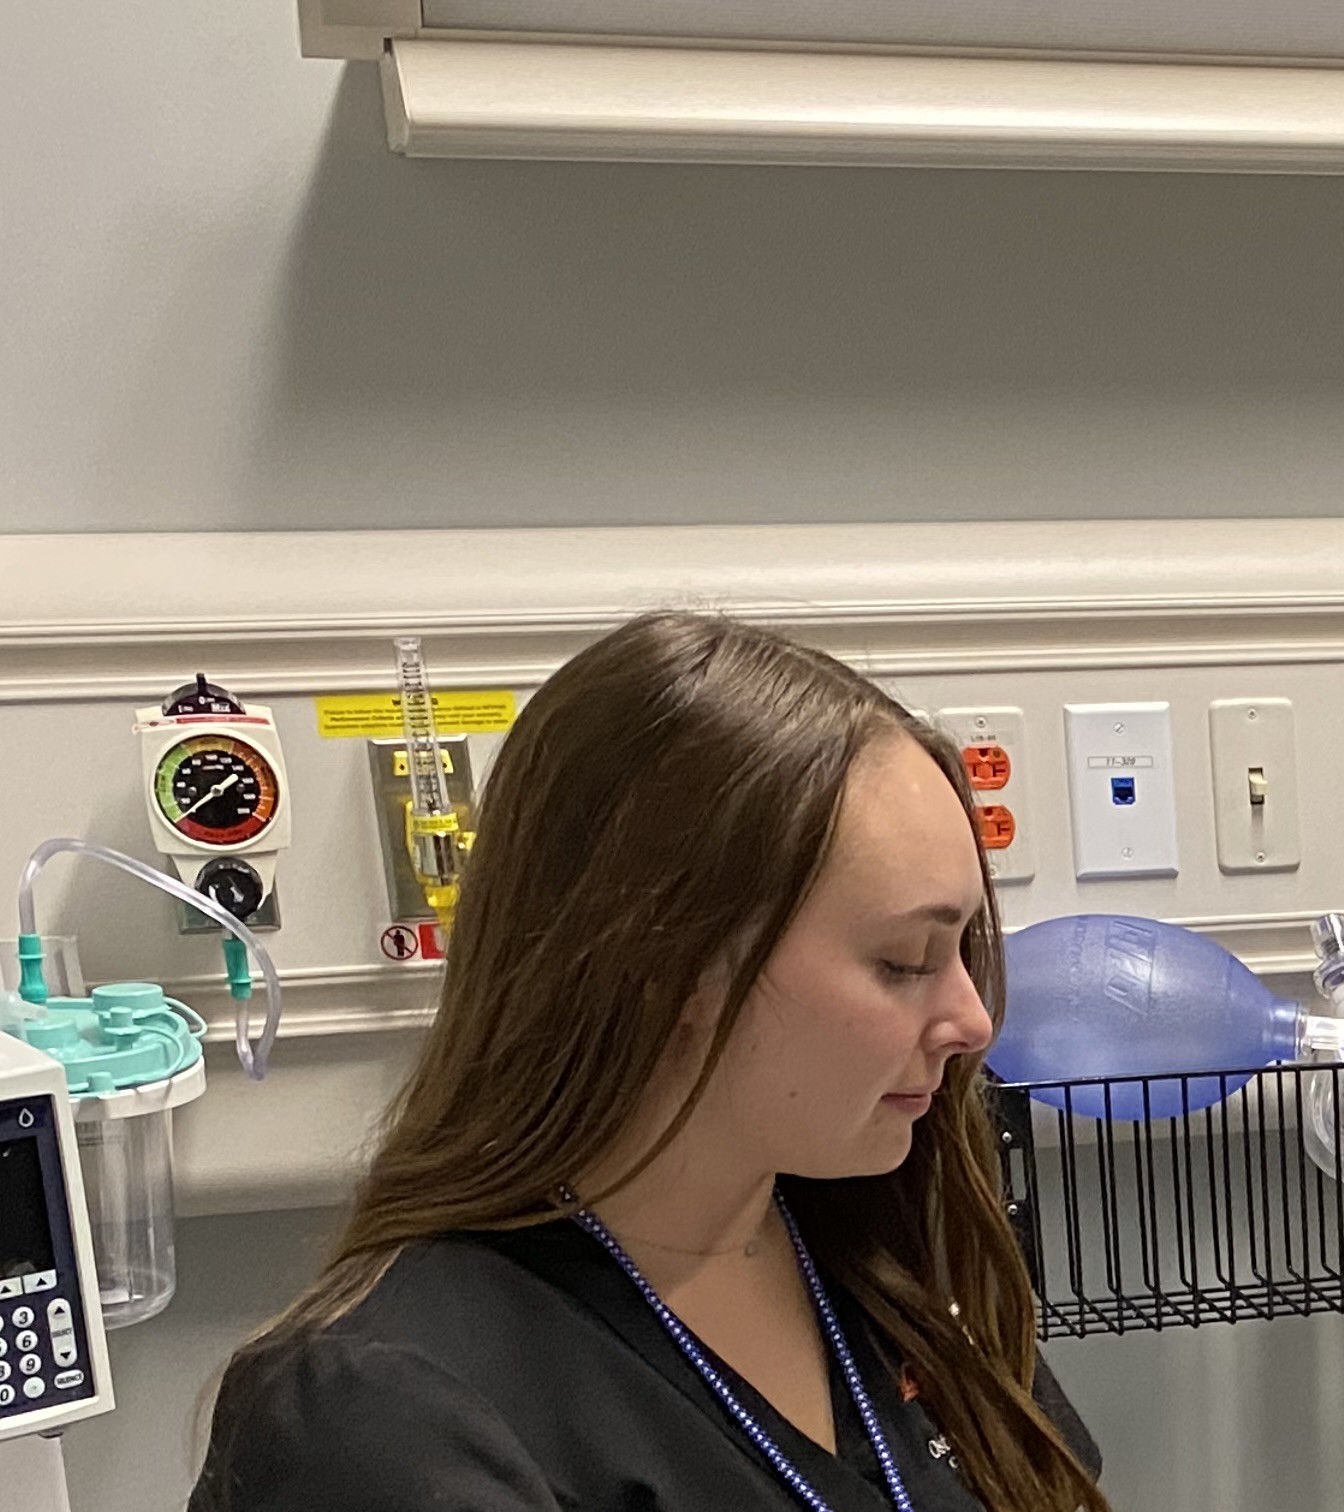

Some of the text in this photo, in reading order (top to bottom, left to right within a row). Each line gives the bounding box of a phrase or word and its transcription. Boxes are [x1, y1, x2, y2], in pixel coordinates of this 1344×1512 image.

[18, 1311, 28, 1325] 3
[22, 1335, 31, 1347] 6
[26, 1358, 36, 1371] 9
[57, 1373, 82, 1385] SILENCE
[0, 1388, 9, 1402] 0
